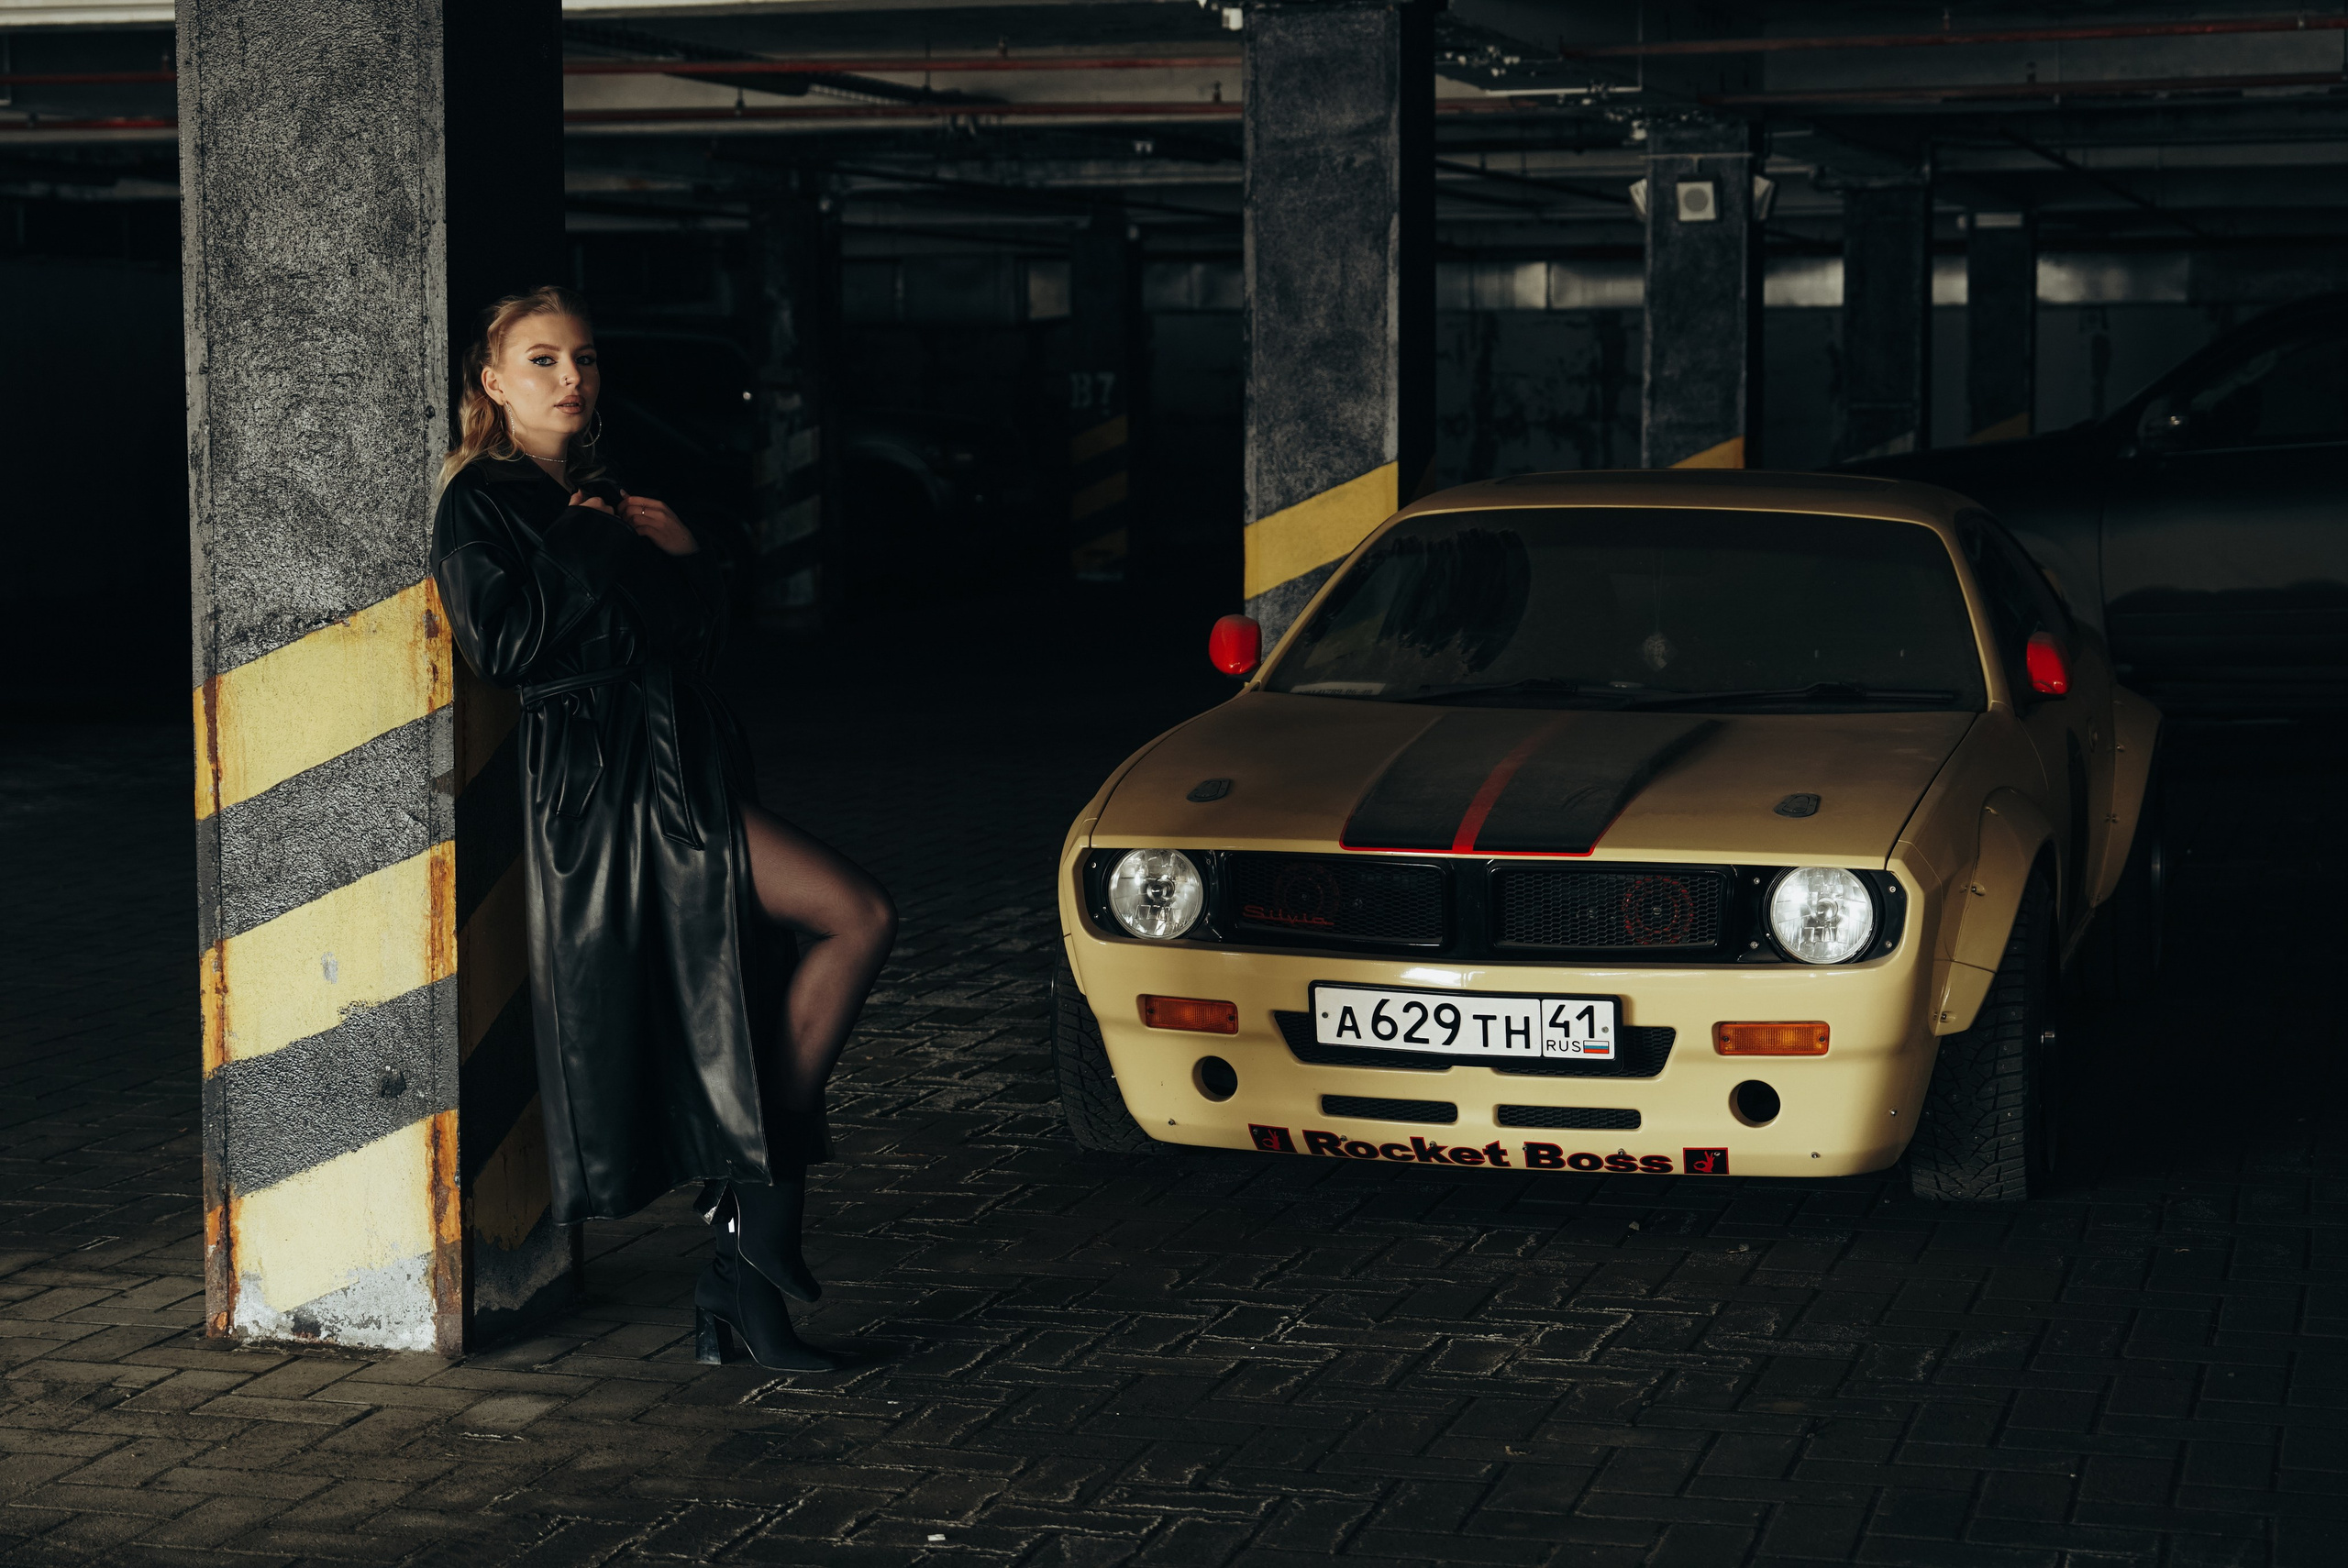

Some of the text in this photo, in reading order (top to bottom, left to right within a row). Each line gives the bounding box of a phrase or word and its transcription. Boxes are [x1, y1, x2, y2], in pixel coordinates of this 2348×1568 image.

[1242, 904, 1335, 927] Silvia
[1548, 1004, 1596, 1039] 41
[1546, 1039, 1581, 1053] RUS
[1301, 1129, 1674, 1174] Rocket Boss
